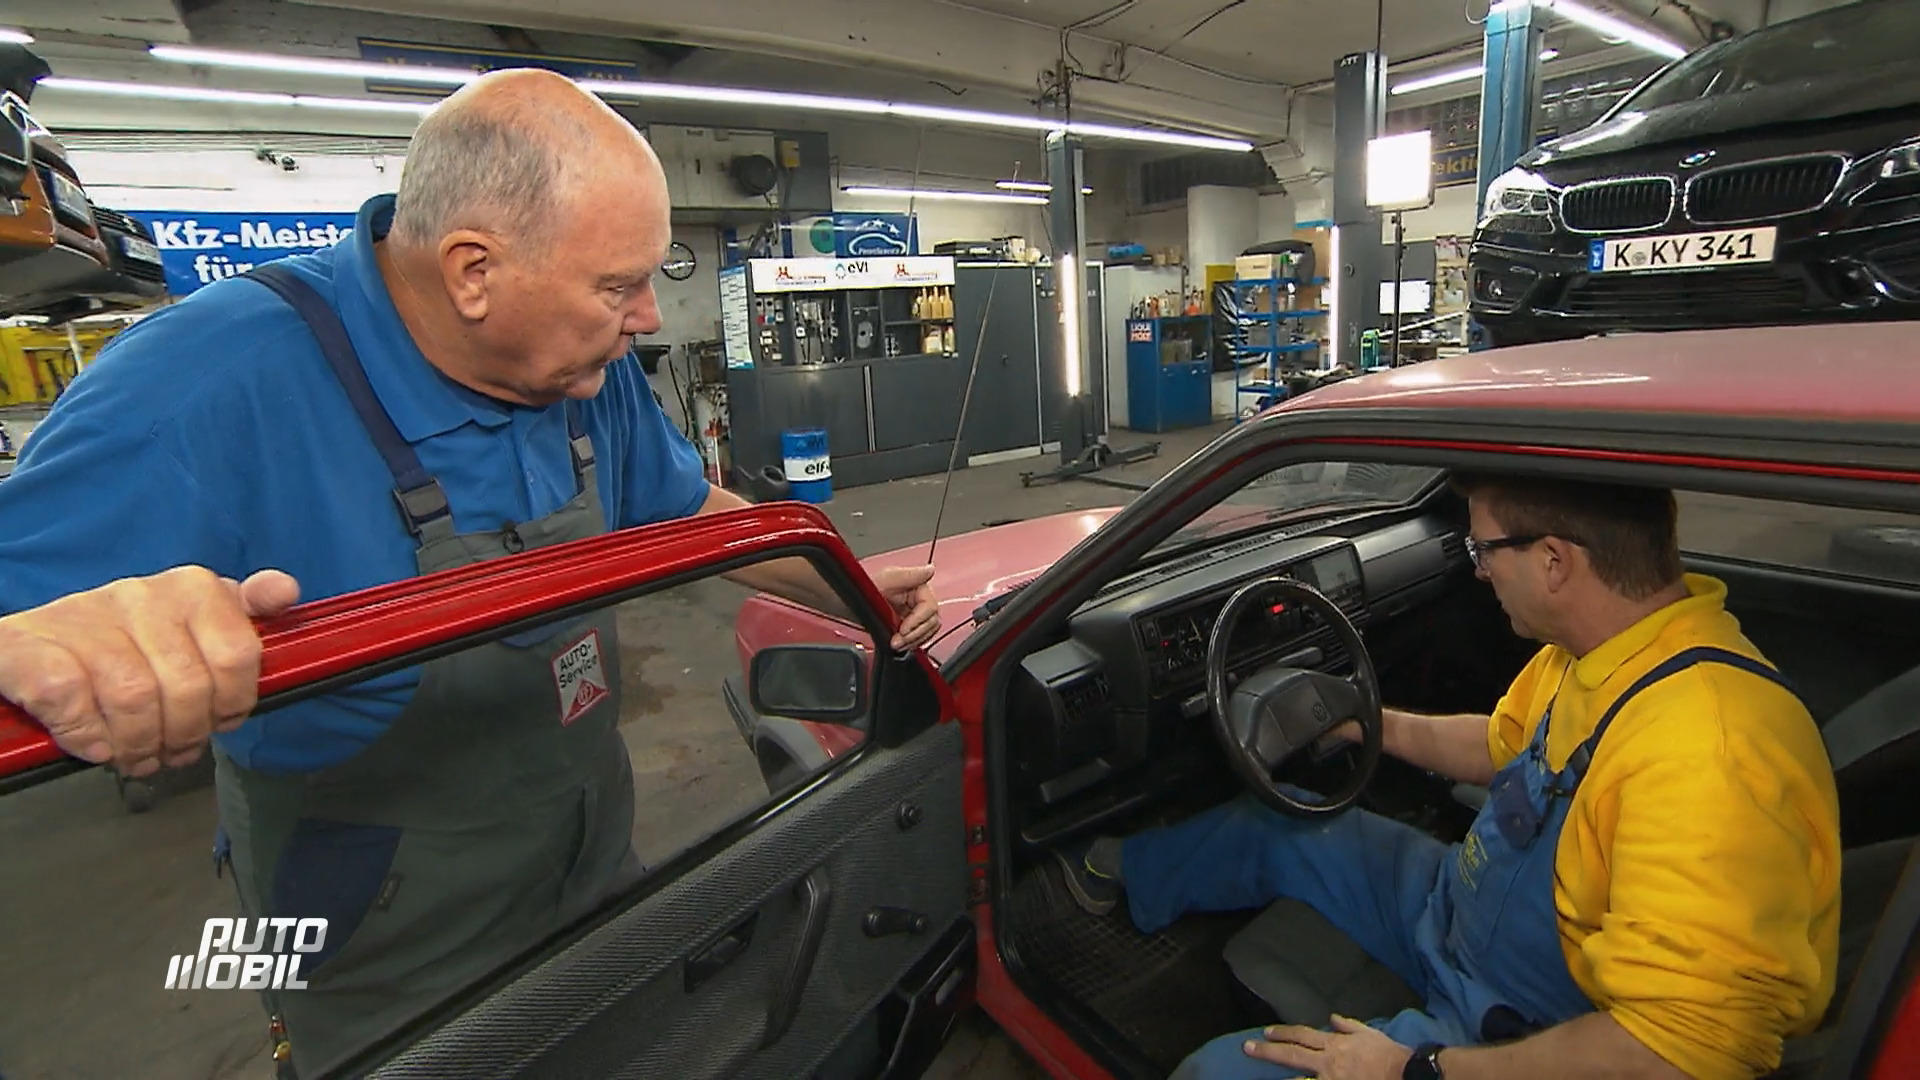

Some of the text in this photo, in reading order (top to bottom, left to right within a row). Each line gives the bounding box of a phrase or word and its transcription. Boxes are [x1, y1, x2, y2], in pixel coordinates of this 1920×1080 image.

[1614, 243, 1632, 267] K
[1650, 239, 1690, 265] KY
[1696, 233, 1756, 261] 341
[804, 461, 825, 475] elf
[559, 654, 598, 689] Service
